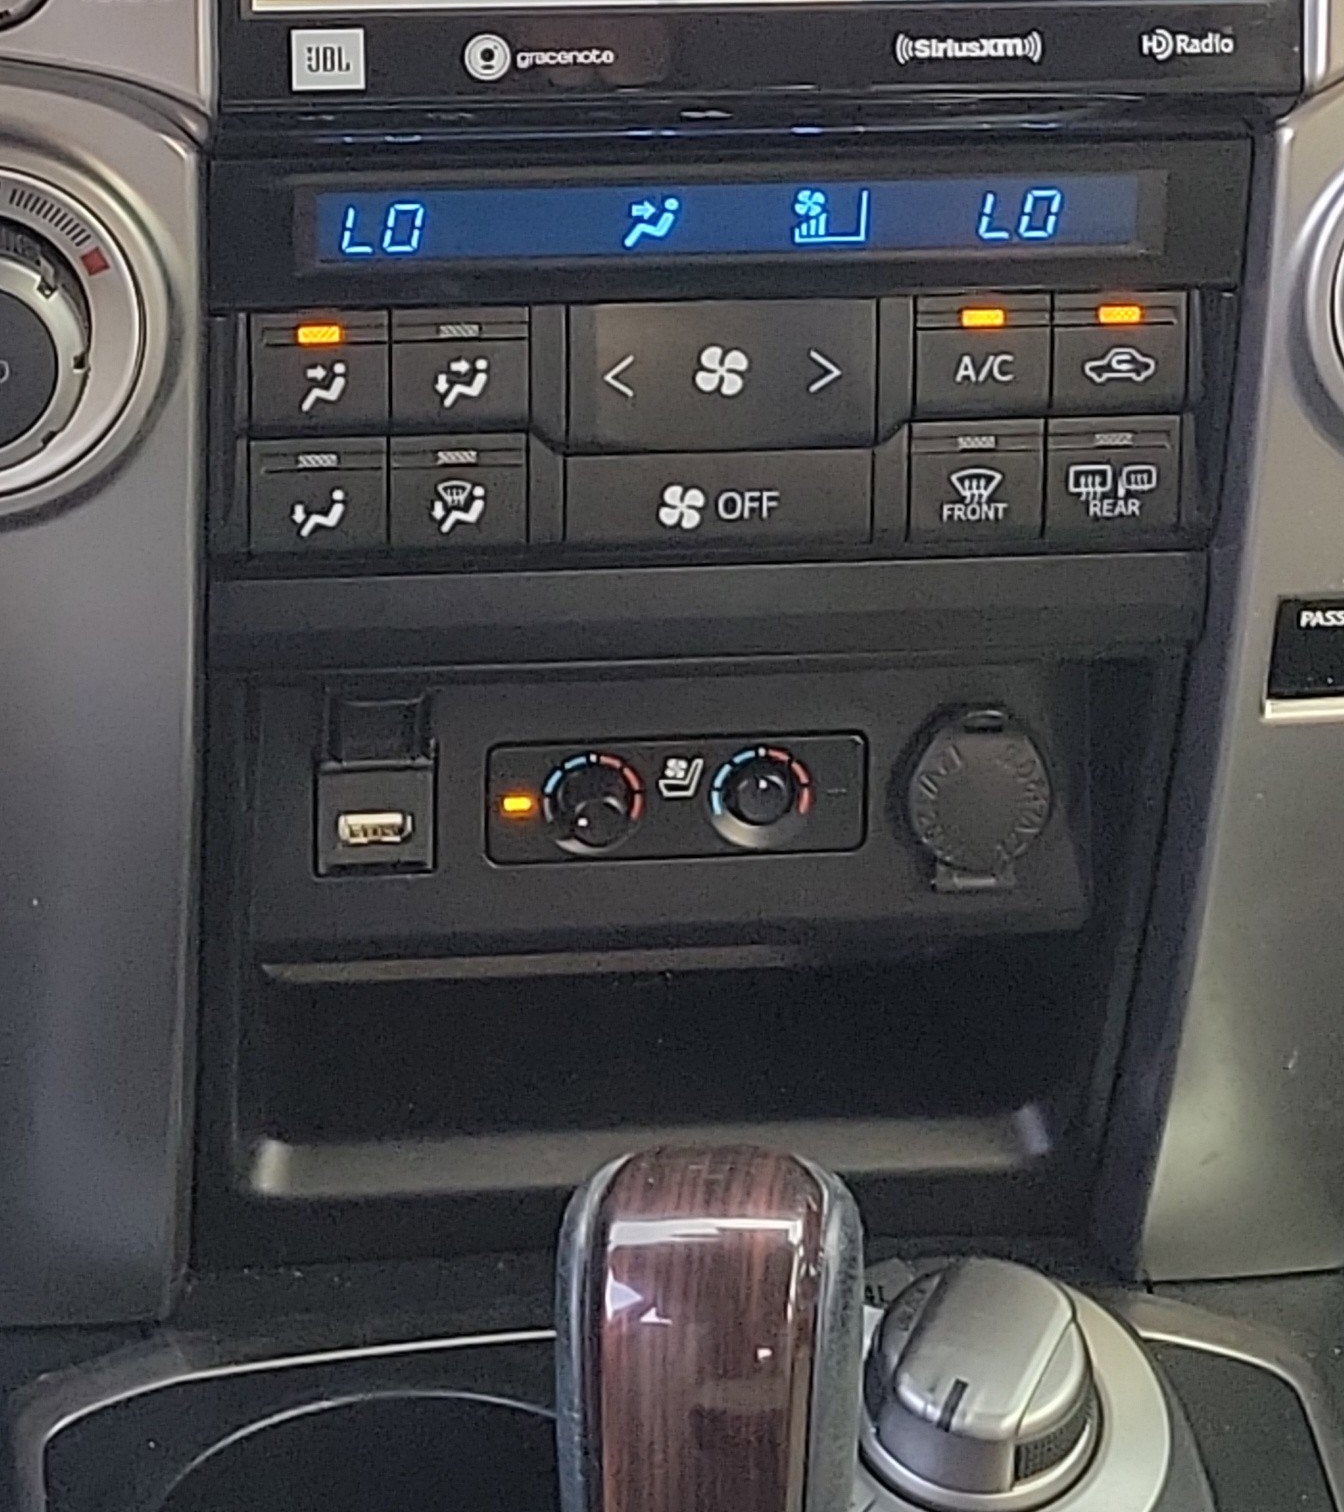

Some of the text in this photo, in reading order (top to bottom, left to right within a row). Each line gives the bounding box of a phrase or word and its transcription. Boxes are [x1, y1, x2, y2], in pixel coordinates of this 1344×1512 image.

[1175, 32, 1234, 54] Radio
[306, 46, 351, 73] JBL
[516, 48, 615, 69] gracenote
[955, 354, 1014, 382] A/C
[718, 491, 780, 520] OFF
[943, 502, 1007, 521] FRONT
[1089, 498, 1140, 516] REAR
